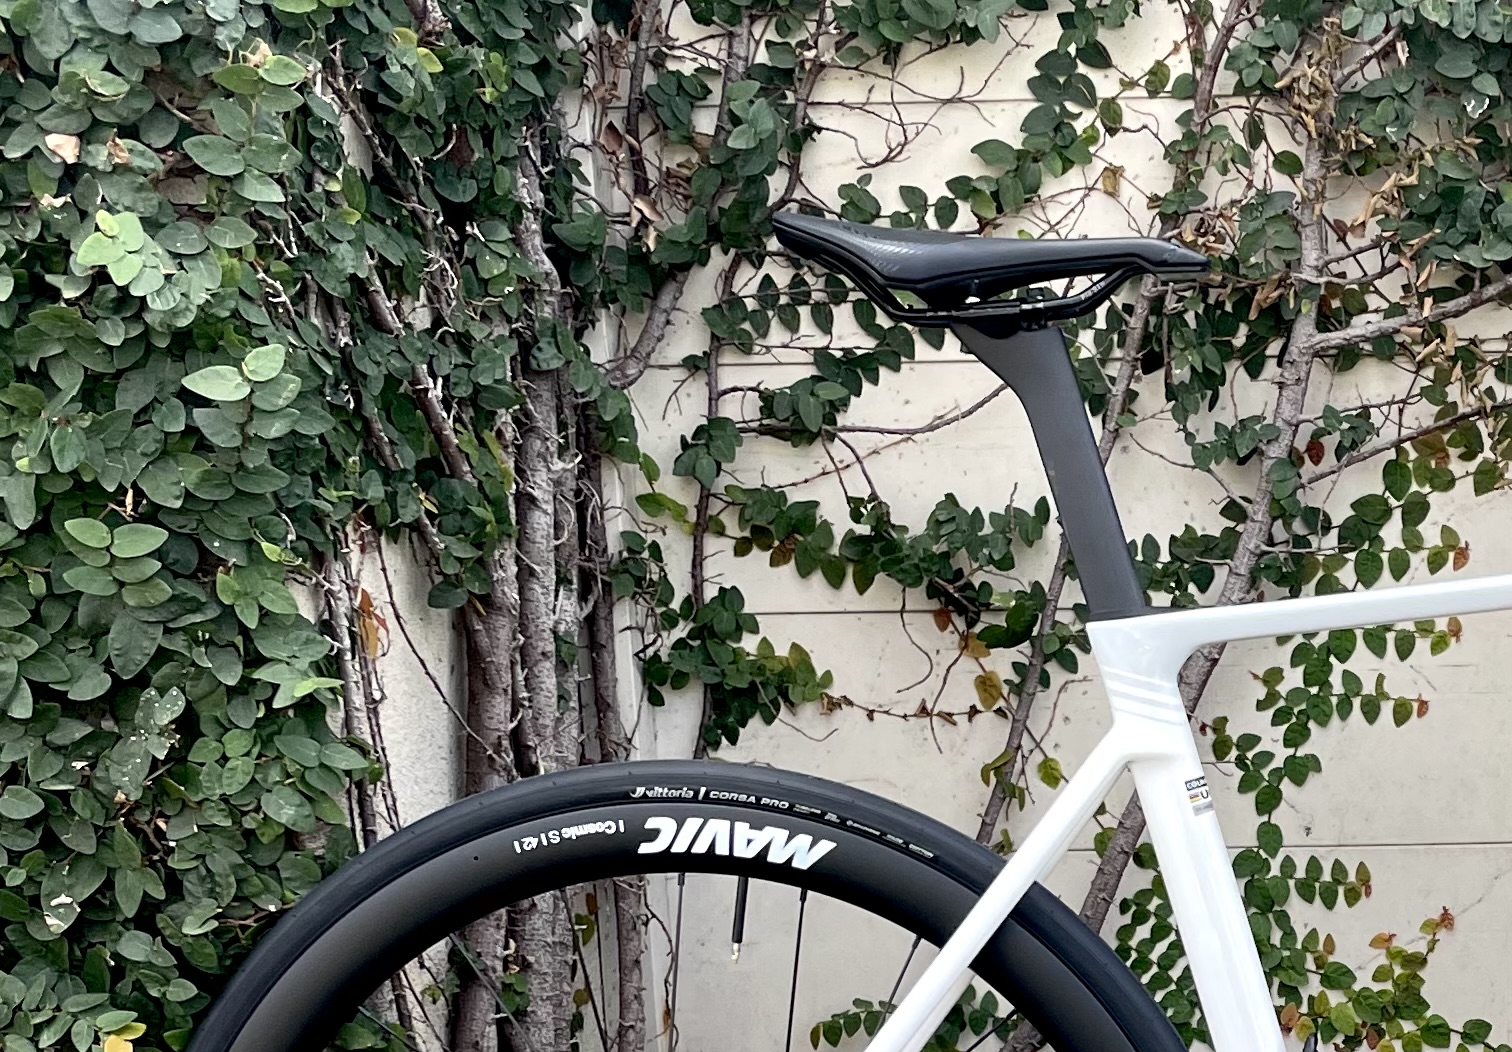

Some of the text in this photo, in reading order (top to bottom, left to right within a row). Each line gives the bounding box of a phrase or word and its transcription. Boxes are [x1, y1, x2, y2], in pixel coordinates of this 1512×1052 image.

[645, 786, 694, 798] vittoria
[760, 796, 789, 809] PRO
[520, 820, 617, 851] Cosmic S 42
[637, 816, 838, 871] MAVIC
